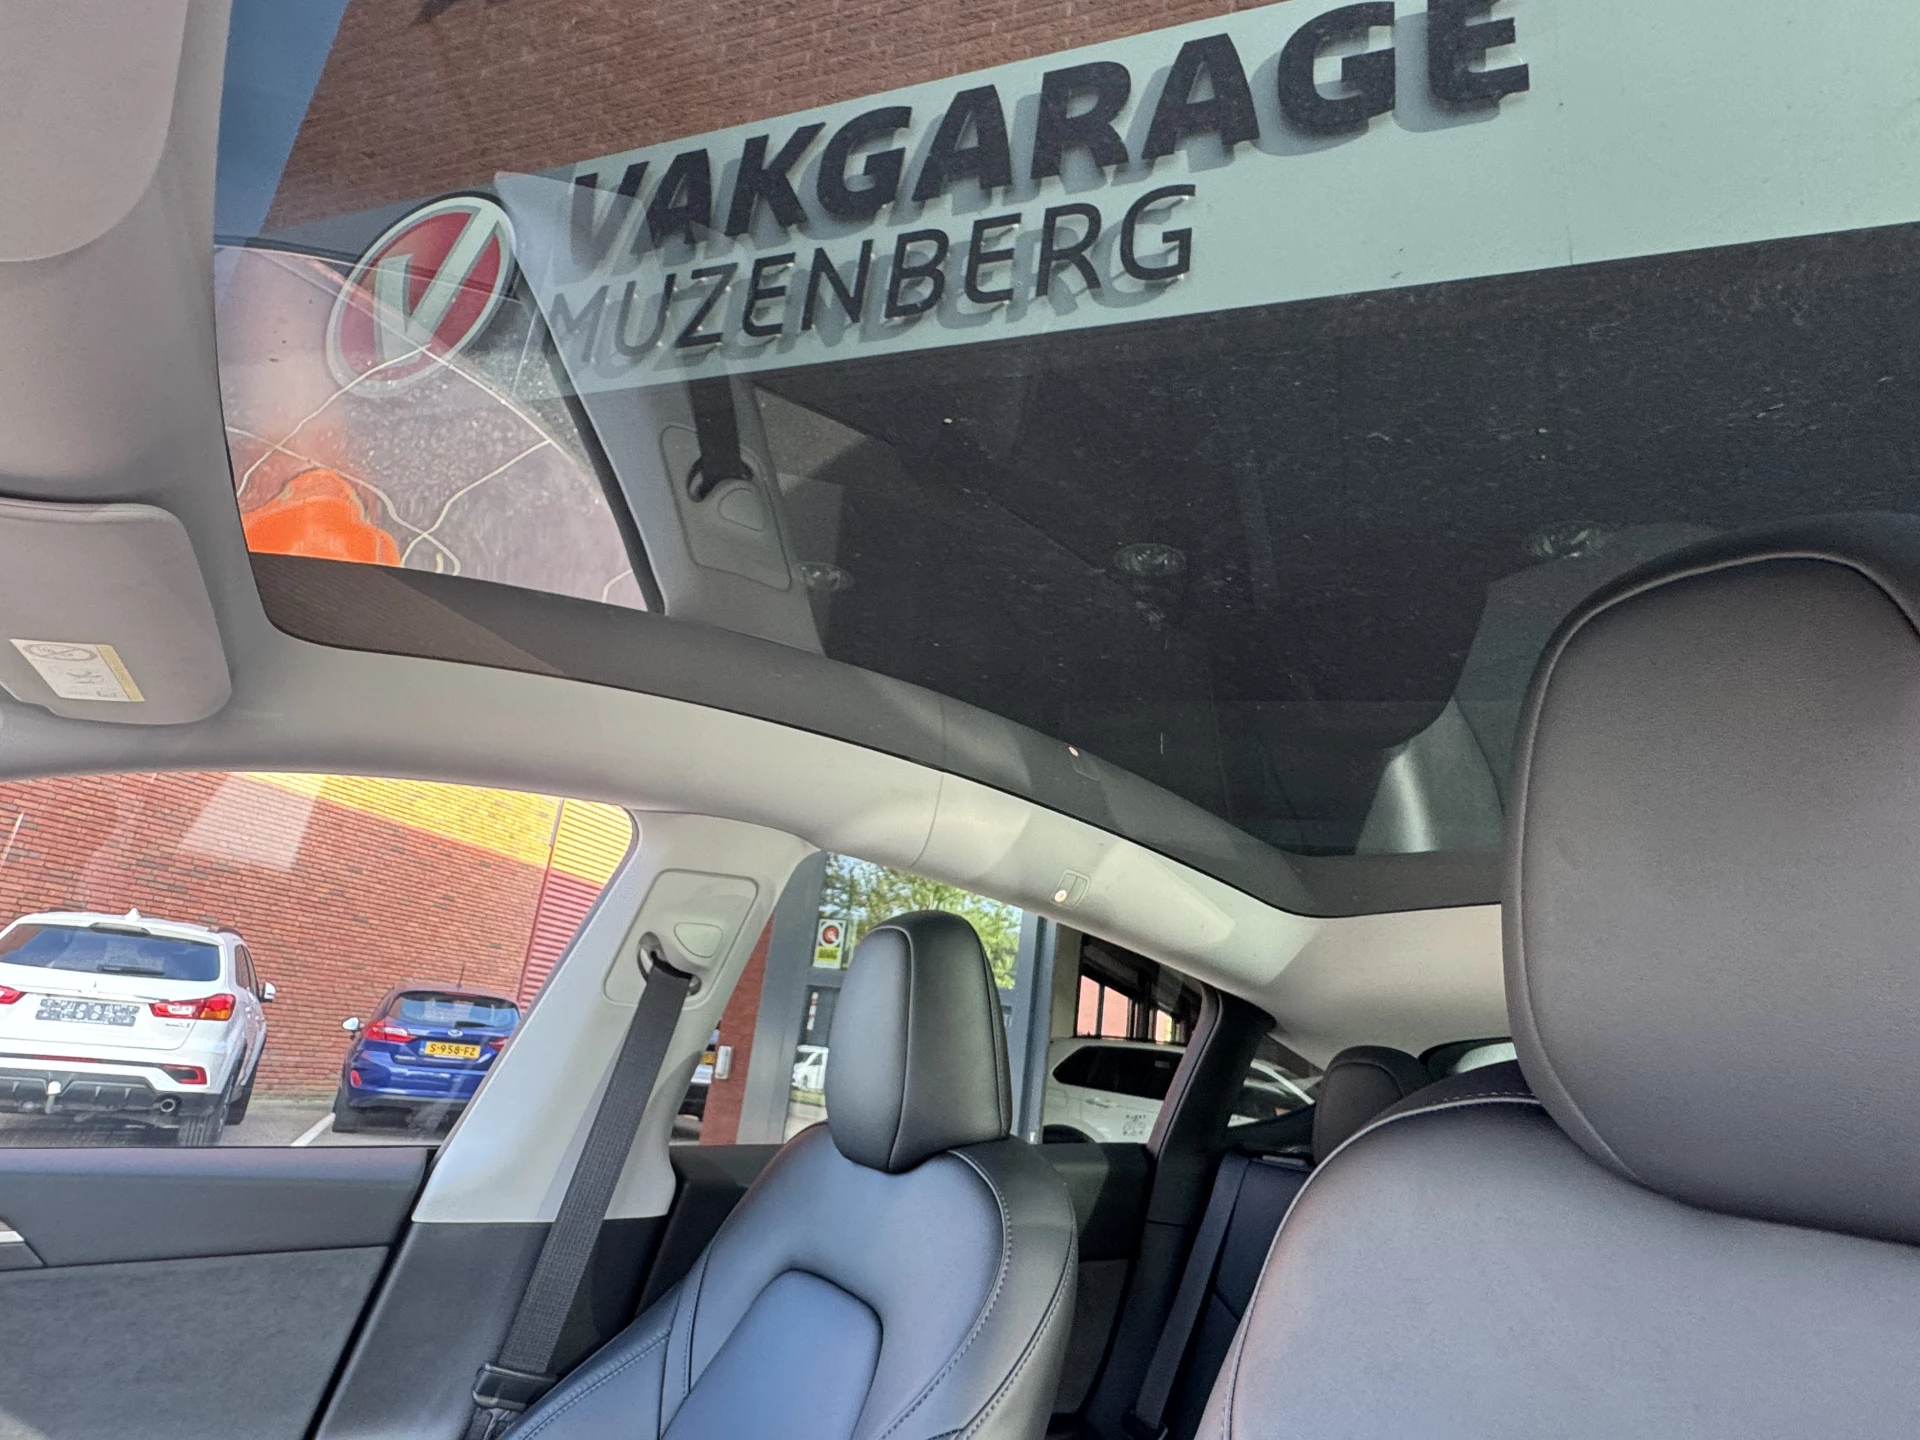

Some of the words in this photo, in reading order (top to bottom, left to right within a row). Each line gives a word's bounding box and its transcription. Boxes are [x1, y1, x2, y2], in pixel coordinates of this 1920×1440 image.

[570, 0, 1531, 260] VAKGARAGE
[547, 184, 1197, 364] MUZENBERG
[429, 1043, 477, 1056] S-958-FZ
